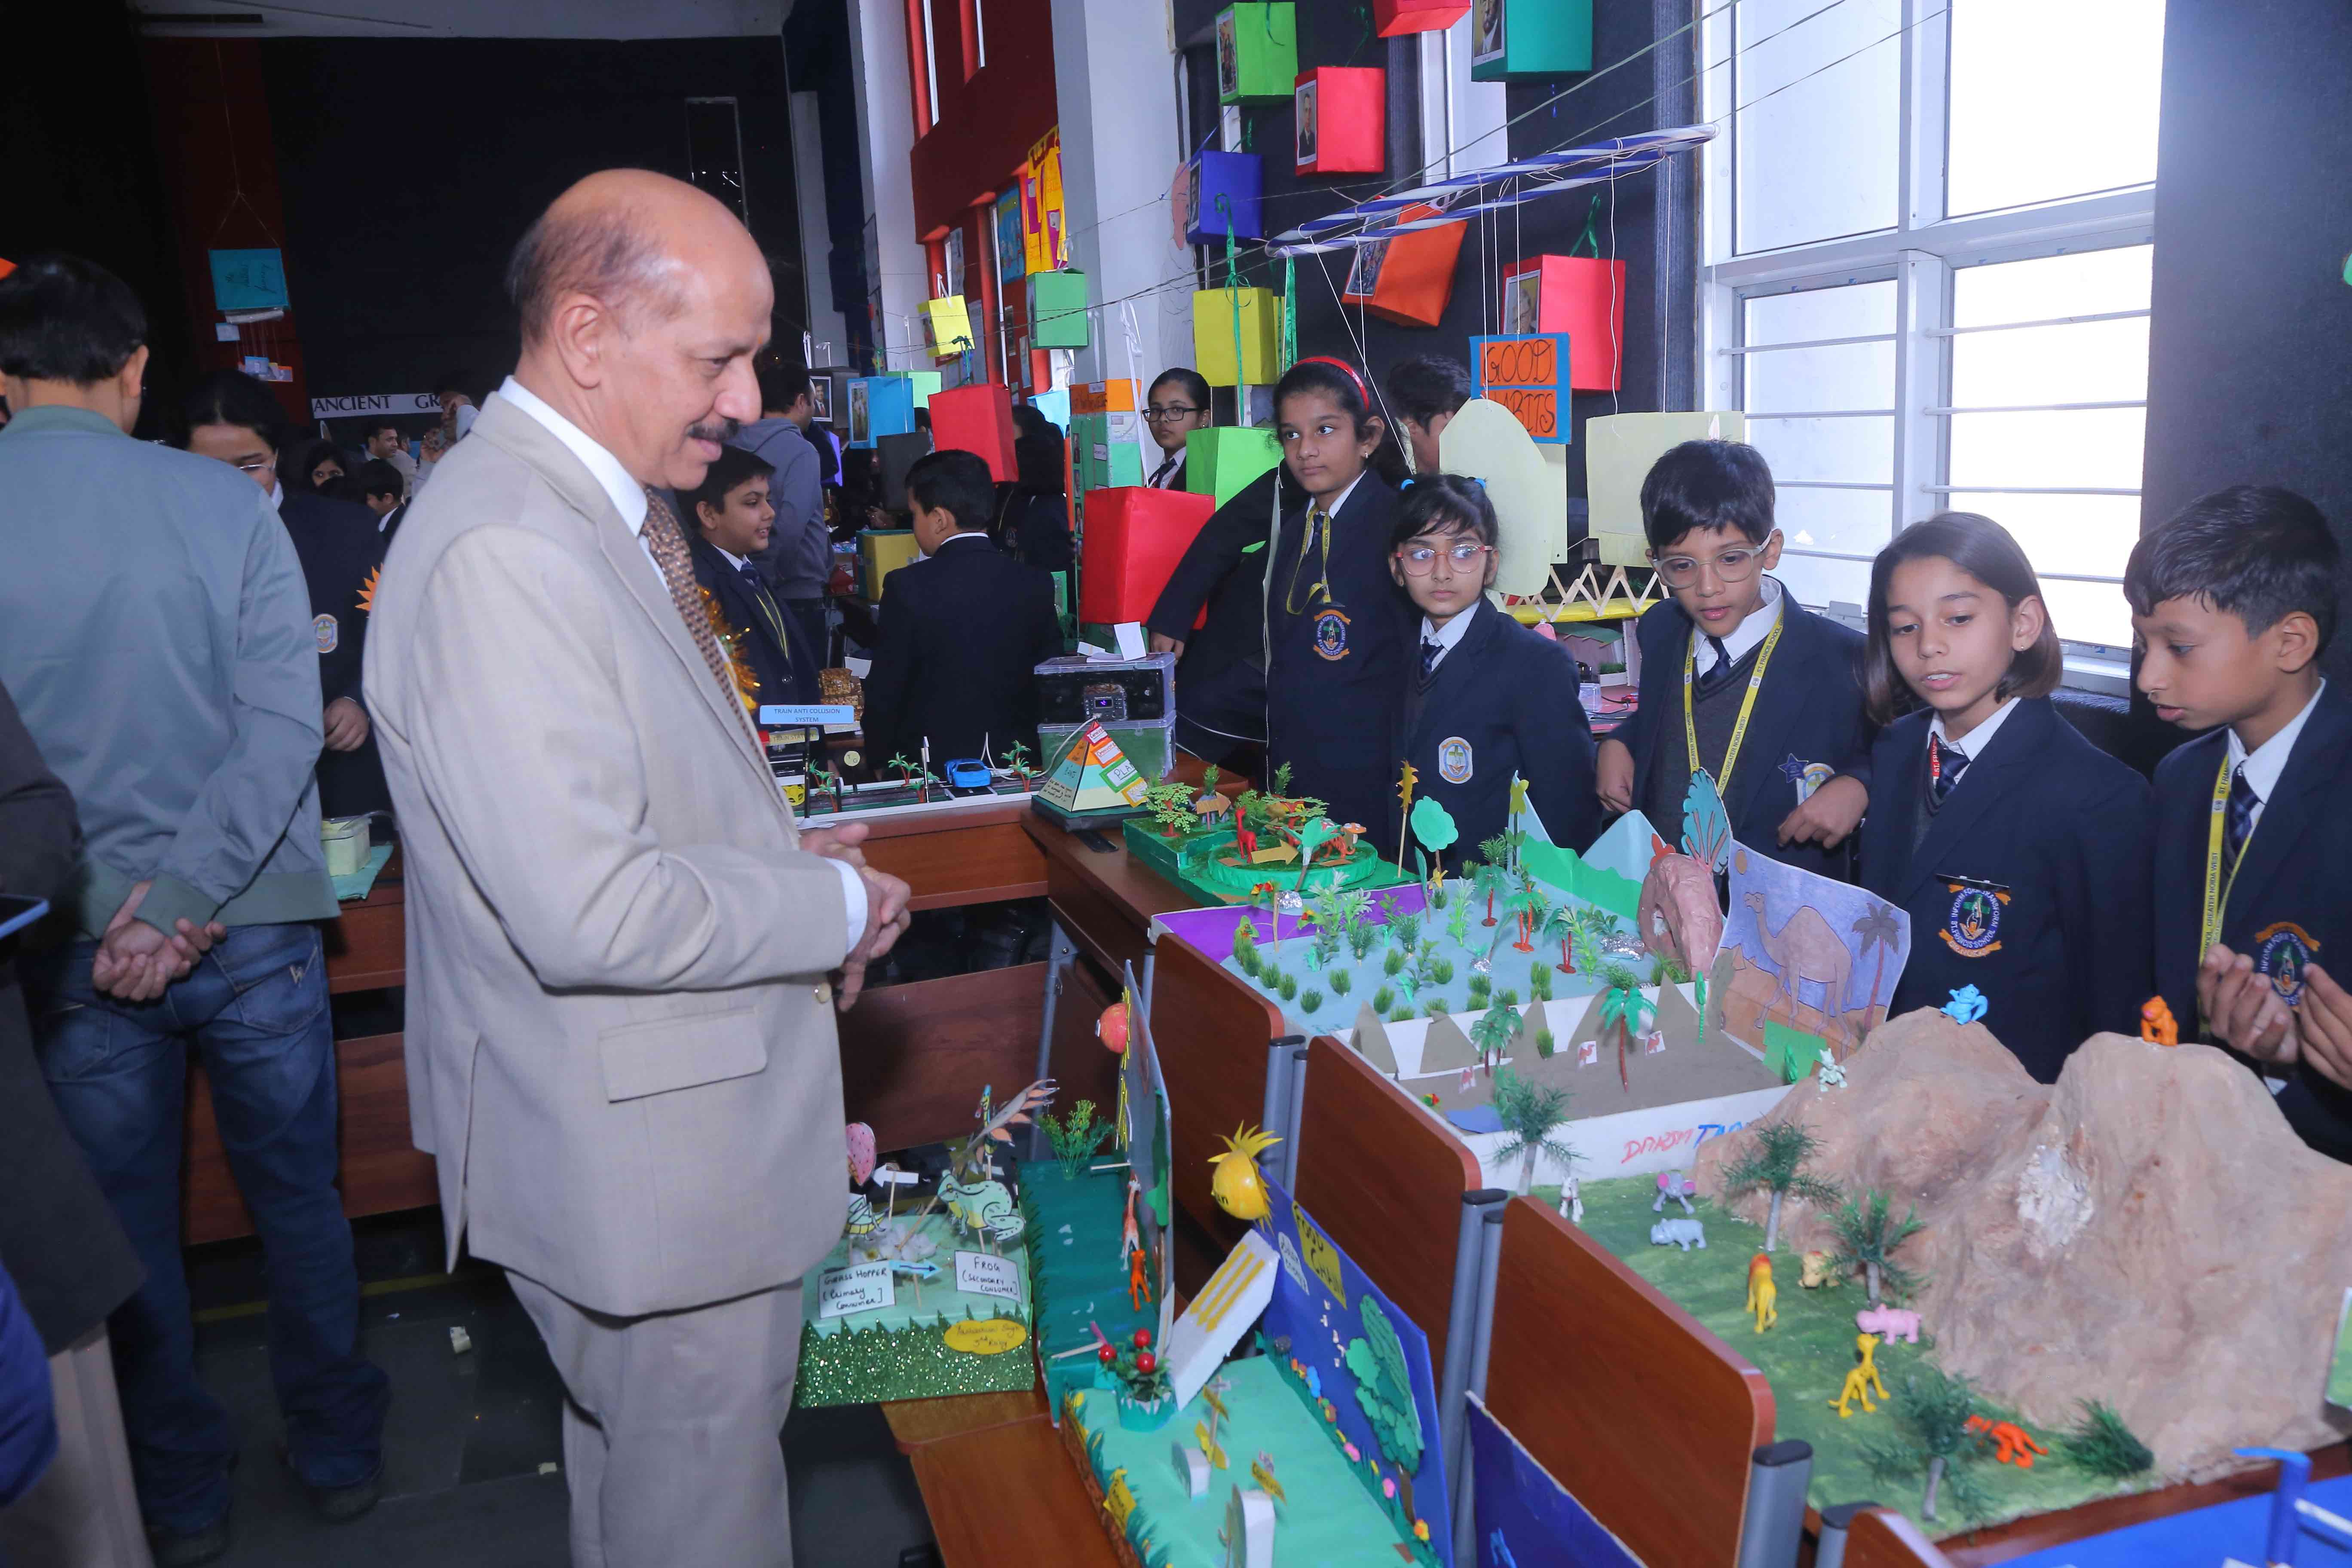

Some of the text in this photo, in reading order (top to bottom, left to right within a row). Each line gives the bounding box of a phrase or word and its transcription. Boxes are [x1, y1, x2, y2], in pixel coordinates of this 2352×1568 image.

[1483, 339, 1552, 383] GOOD
[313, 394, 443, 412] ANCIENT GR
[1494, 389, 1555, 433] BITS
[1726, 716, 1747, 771] GREATER NOIDA WEST
[1951, 893, 1965, 917] INFORM
[1974, 930, 1995, 948] SCHOOL
[974, 1256, 1000, 1272] FROG
[824, 1268, 887, 1285] GRASS HOPPER
